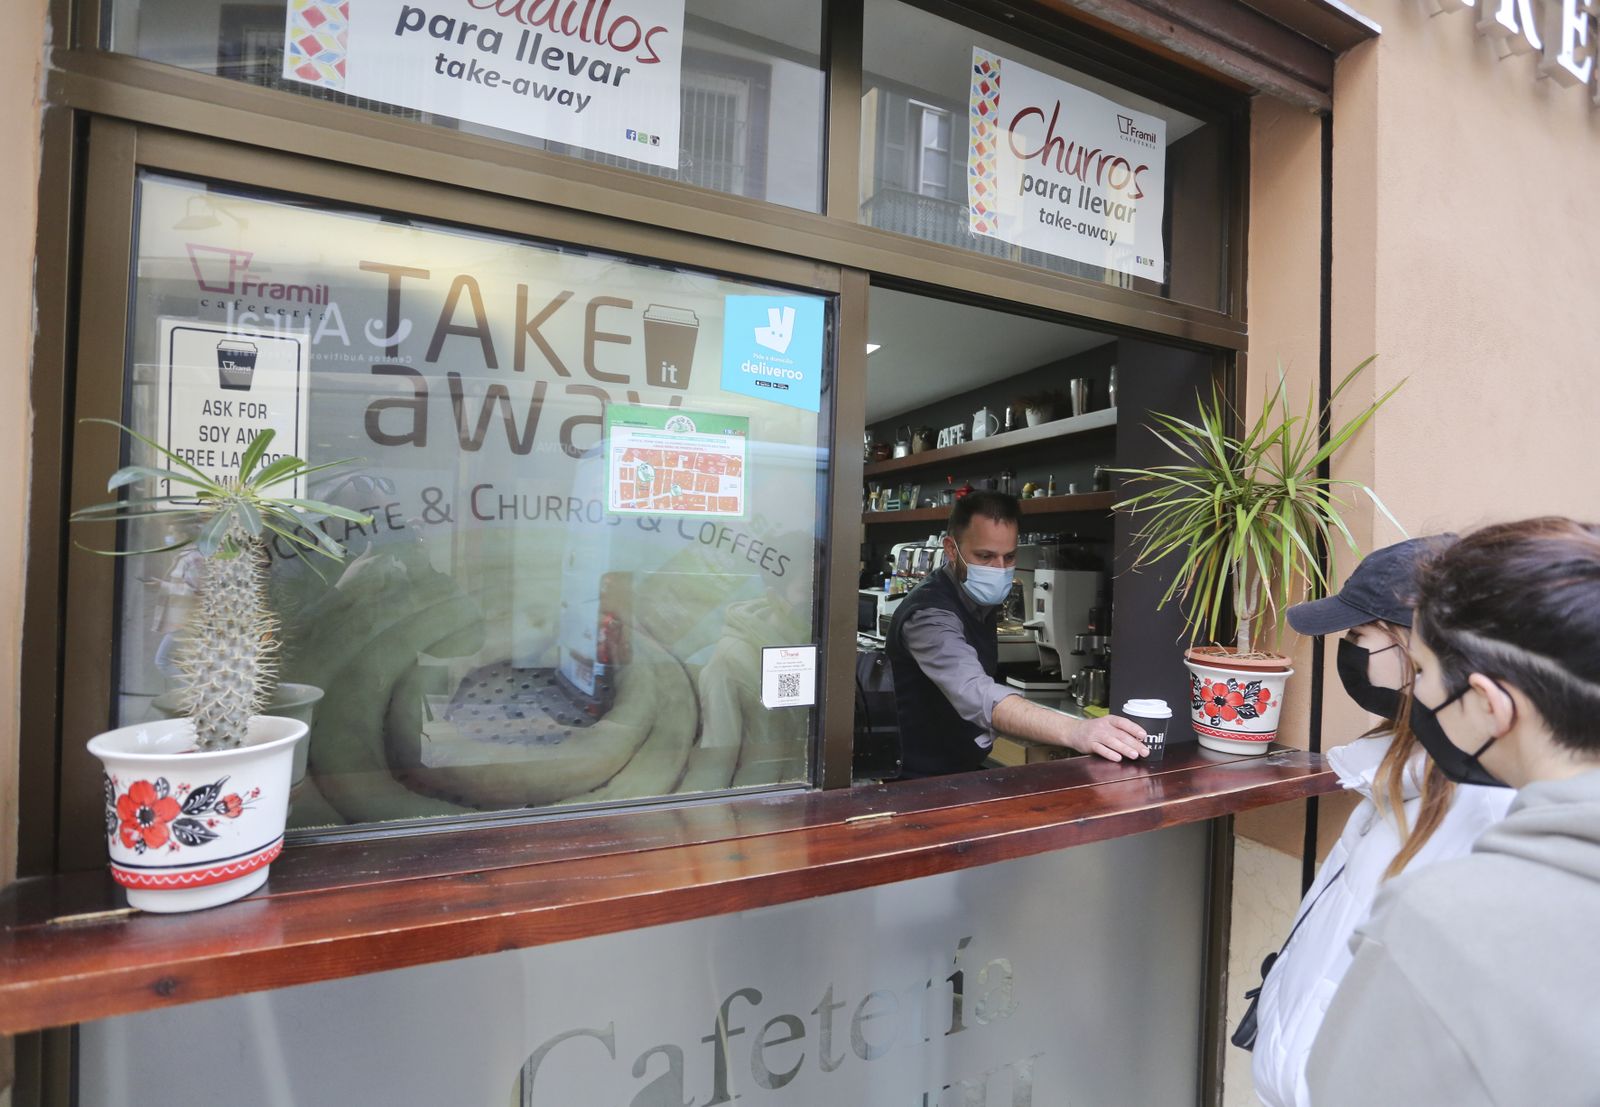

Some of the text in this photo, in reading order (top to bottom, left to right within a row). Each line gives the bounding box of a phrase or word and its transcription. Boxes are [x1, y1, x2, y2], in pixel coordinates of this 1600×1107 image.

[394, 4, 629, 87] para llevar
[434, 52, 592, 113] take-away
[1007, 99, 1150, 201] Churros
[1130, 126, 1157, 143] Framil
[1019, 173, 1136, 223] para llevar
[1039, 207, 1117, 245] take-away
[242, 274, 329, 305] Framil
[358, 260, 679, 385] TAKE it
[741, 360, 803, 380] deliveroo
[202, 399, 268, 420] ASK FOR
[363, 363, 684, 461] awa
[199, 425, 266, 445] SOY AN
[175, 448, 216, 468] FREE
[420, 486, 454, 525] &
